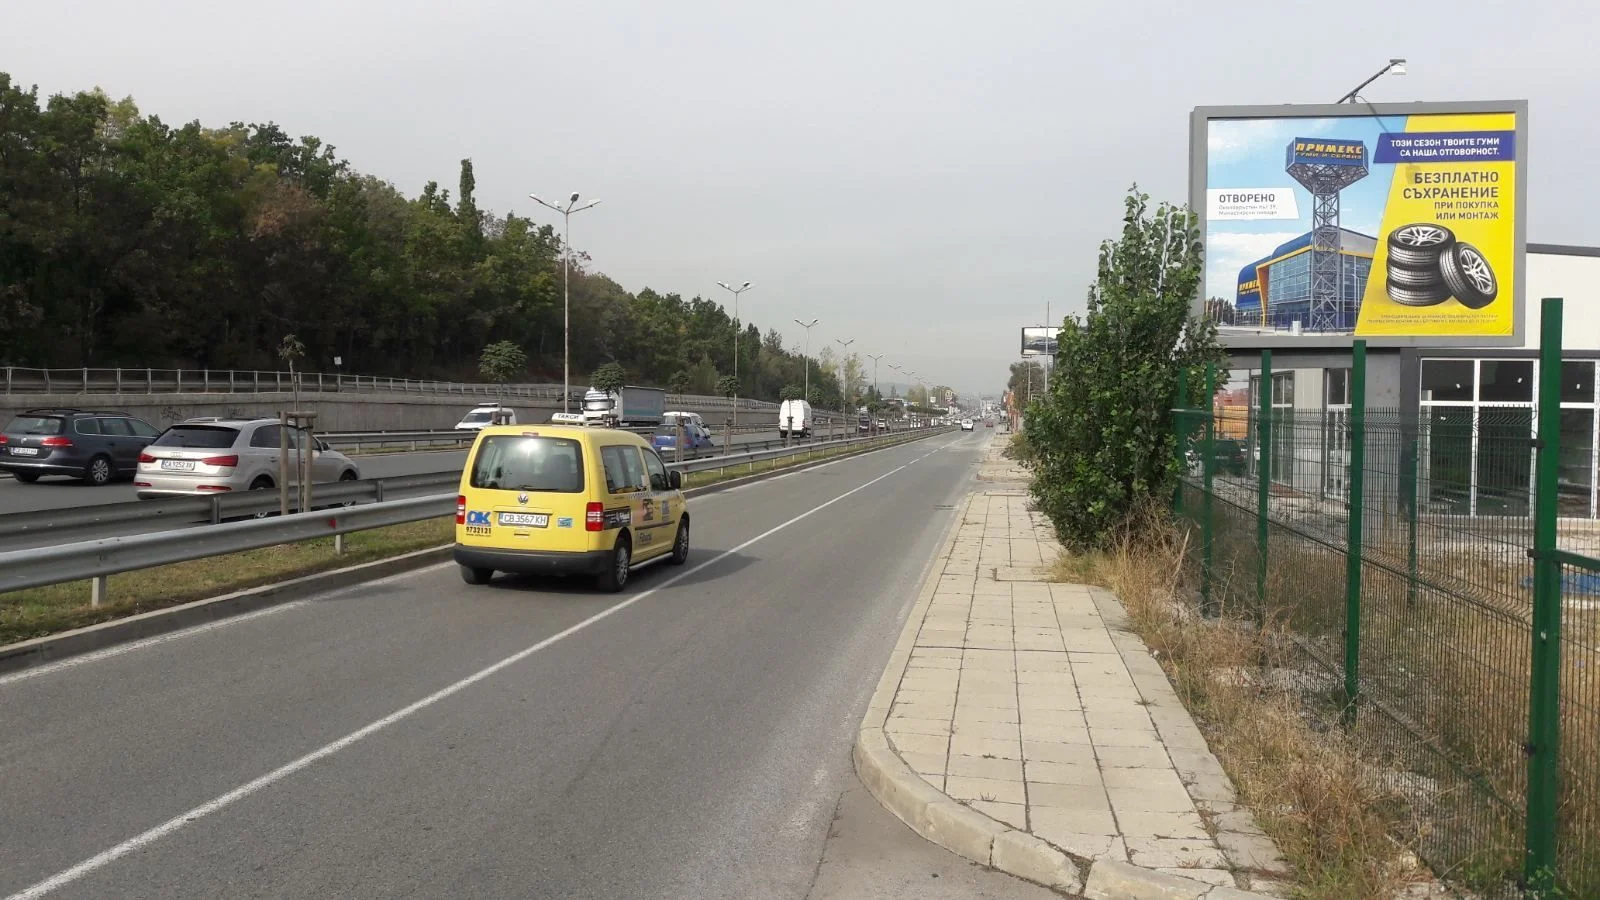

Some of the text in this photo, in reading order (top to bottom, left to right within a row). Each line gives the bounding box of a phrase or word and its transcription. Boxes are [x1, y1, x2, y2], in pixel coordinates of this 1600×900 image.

[1414, 139, 1441, 147] СЕЗОН
[1443, 138, 1475, 146] ТВОИТЕ
[1477, 137, 1500, 146] ГУМИ
[1296, 143, 1362, 154] ПРИМЕКС
[1400, 147, 1500, 157] СА НАША ОТГОВОРНОСТ.
[1414, 172, 1499, 184] БЕЗПЛАТНО
[1219, 193, 1275, 203] ОТВОРЕНО
[1403, 187, 1499, 199] СЪХРАНЕНИЕ
[1456, 201, 1499, 209] ПОКУПКА
[1436, 211, 1499, 220] ИЛИ МОНТАЖ
[466, 510, 492, 524] OK
[504, 514, 546, 524] CB 3567 KH
[466, 526, 492, 534] 9732121
